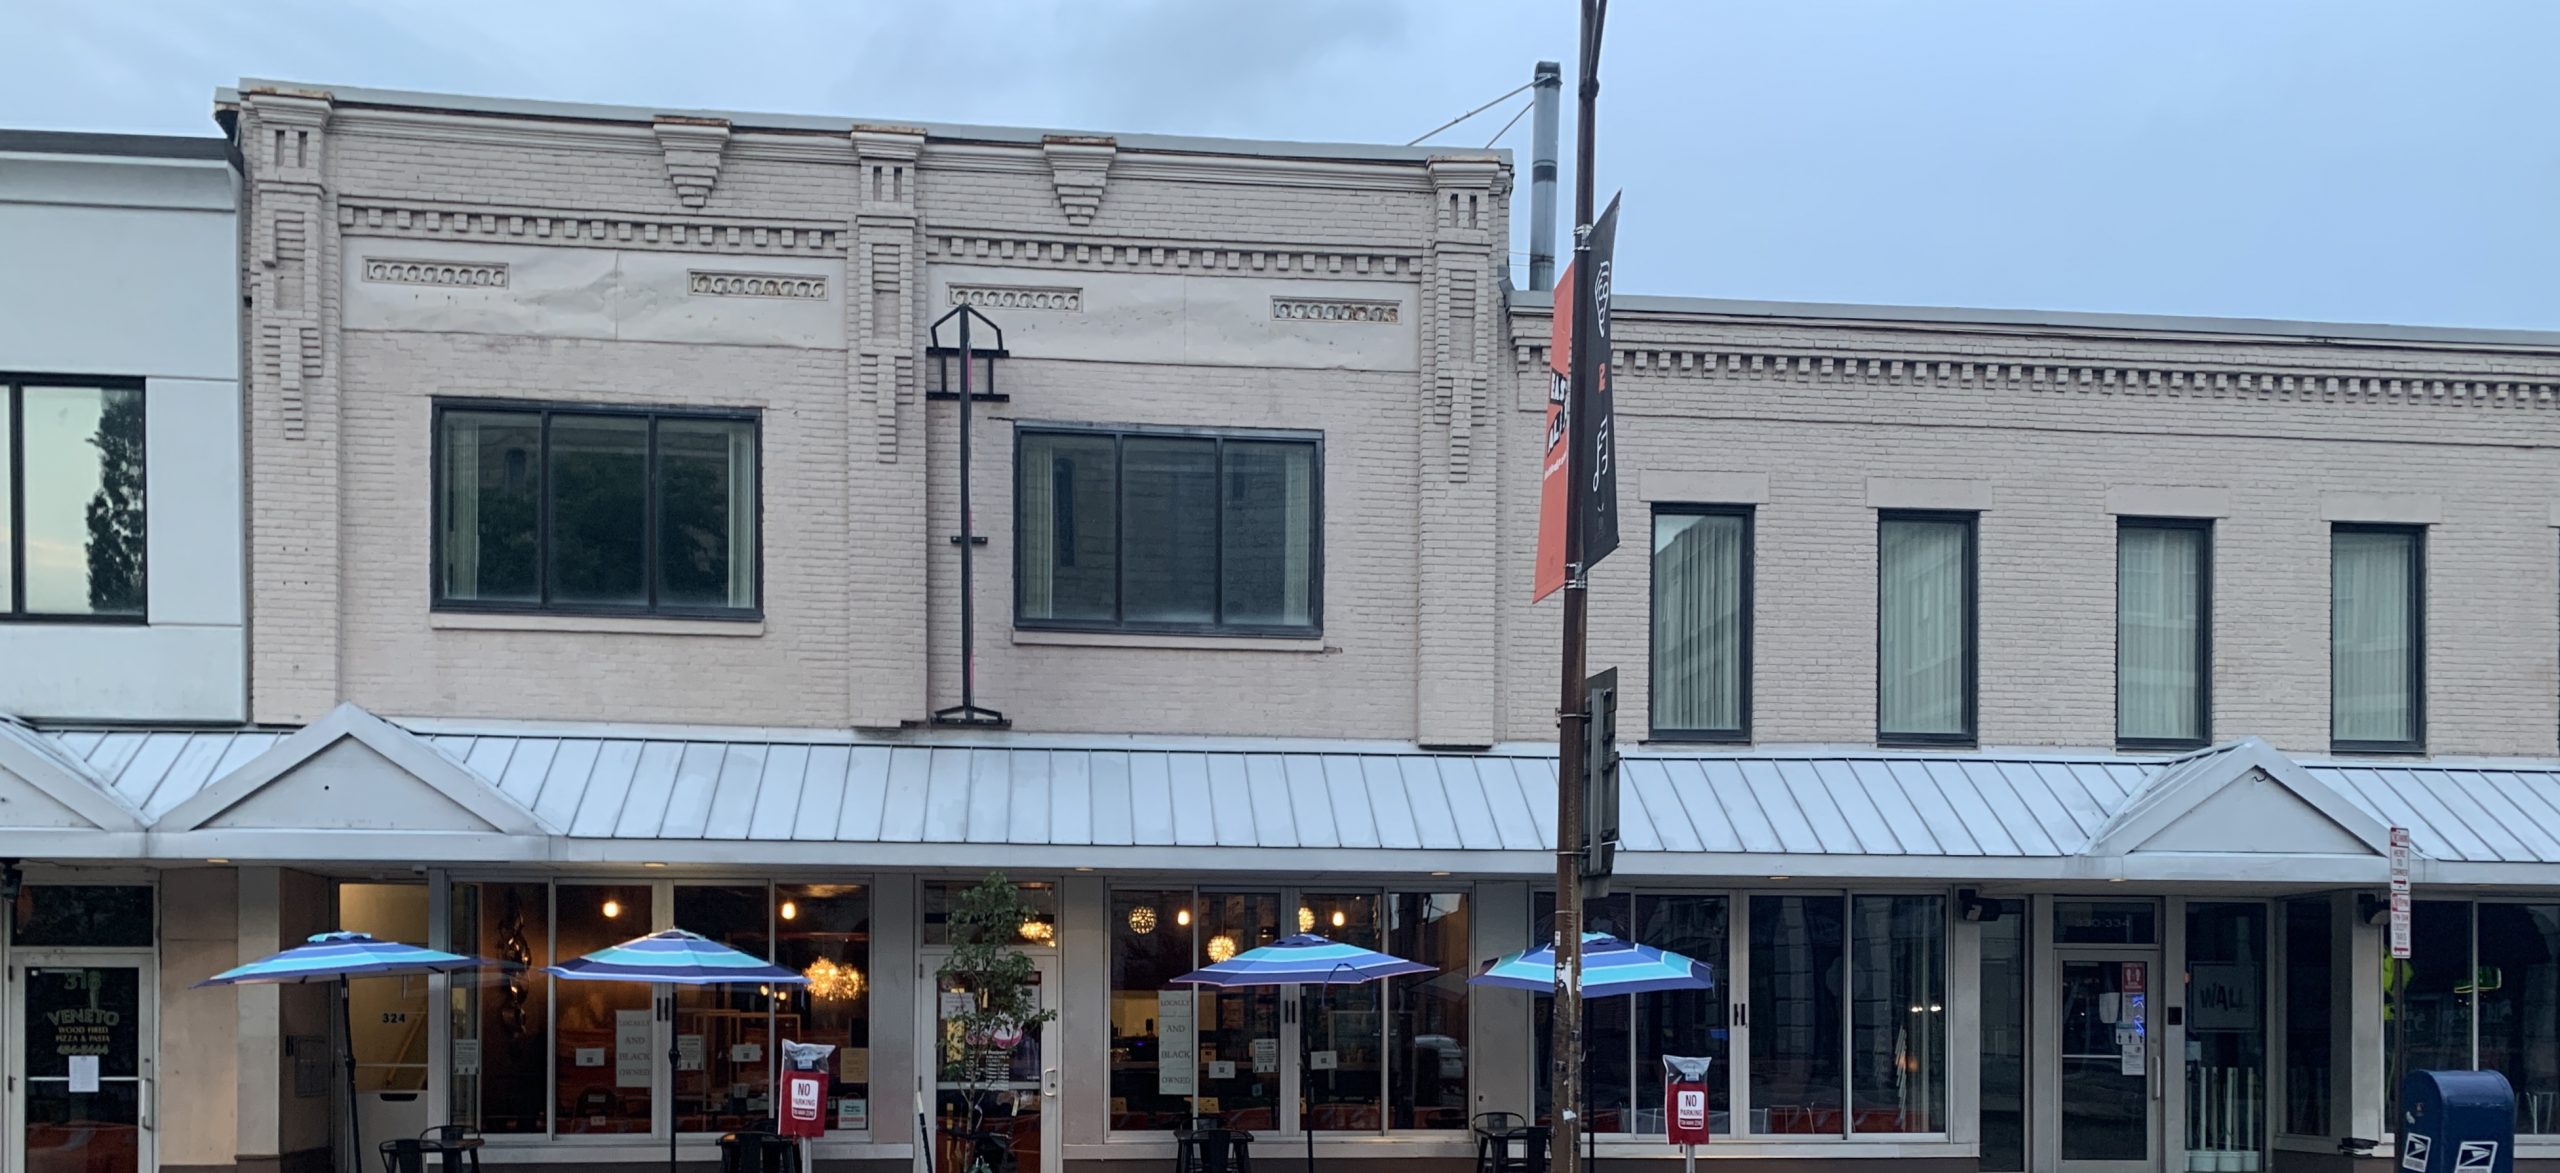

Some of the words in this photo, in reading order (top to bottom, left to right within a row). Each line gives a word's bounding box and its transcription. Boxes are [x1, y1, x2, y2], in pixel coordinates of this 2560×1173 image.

[47, 1008, 120, 1026] VENETO
[382, 1013, 406, 1023] 324
[58, 1026, 86, 1034] WOOD
[1166, 1025, 1185, 1033] AND
[625, 1036, 646, 1045] AND
[619, 1053, 651, 1061] BLACK
[1161, 1050, 1191, 1059] BLACK
[619, 1069, 650, 1077] OWNED
[1161, 1076, 1191, 1084] OWNED
[797, 1083, 811, 1096] NO
[1685, 1094, 1697, 1106] NO
